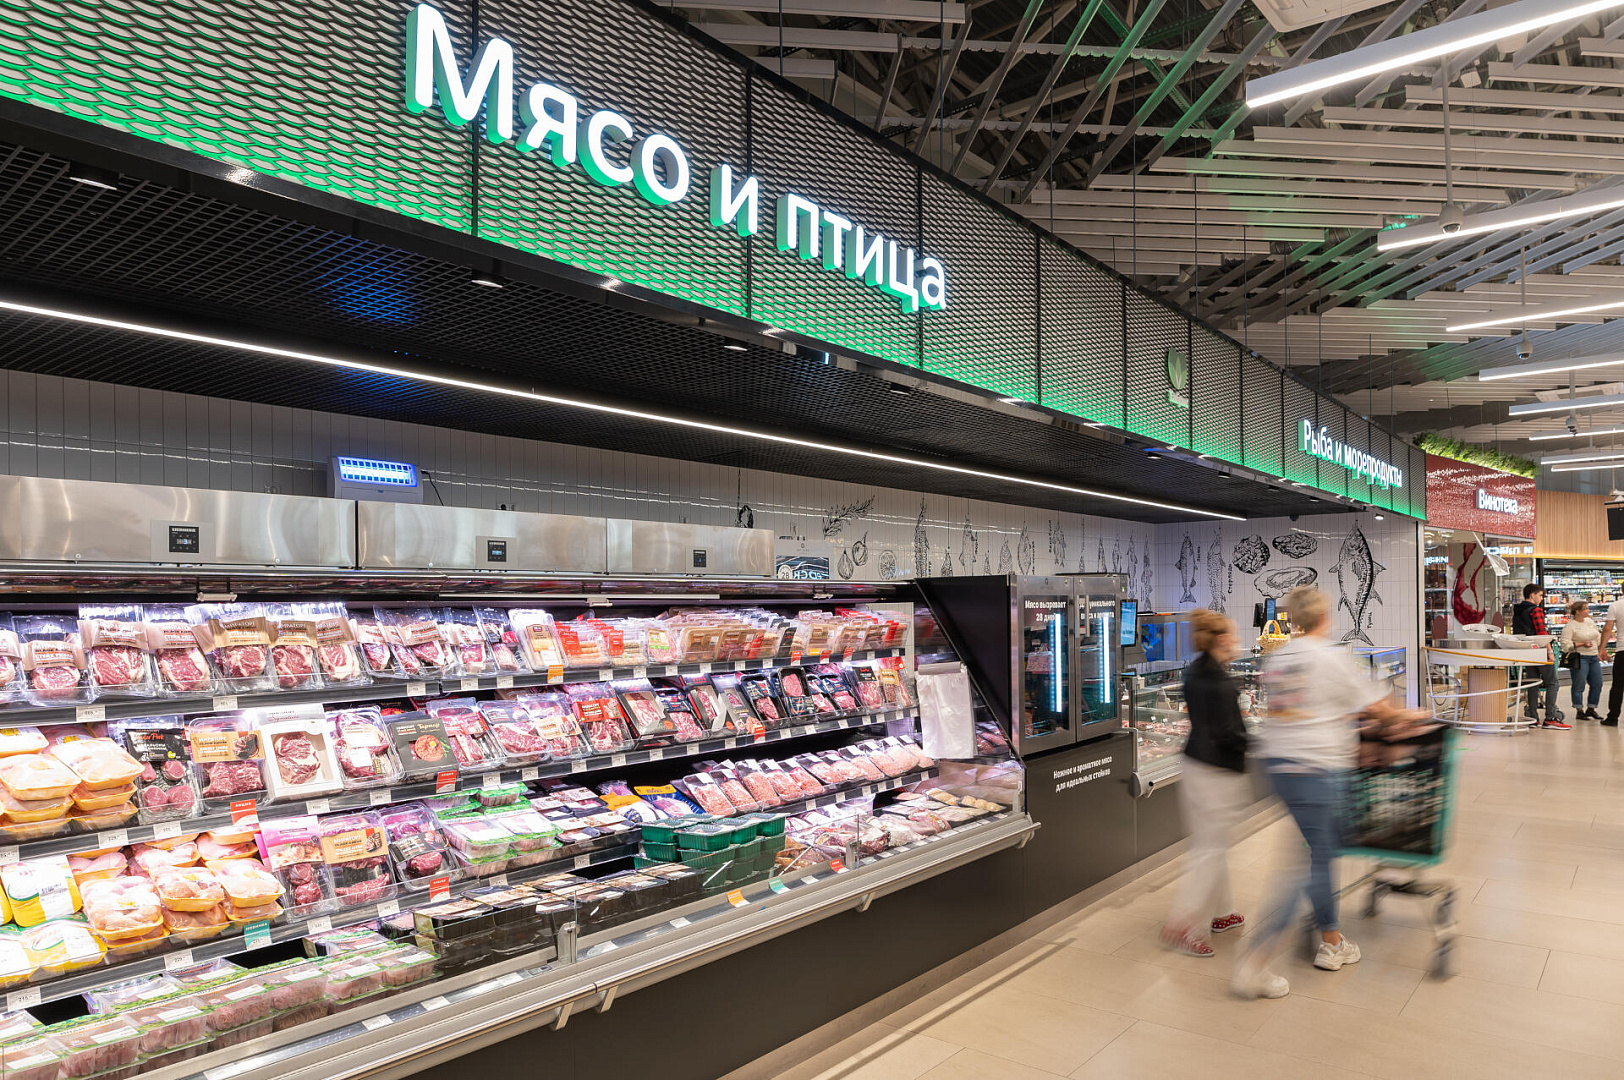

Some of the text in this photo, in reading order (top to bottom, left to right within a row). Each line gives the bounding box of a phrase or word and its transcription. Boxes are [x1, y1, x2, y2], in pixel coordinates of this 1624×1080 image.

[407, 3, 947, 312] Мясо и птица
[1301, 418, 1403, 490] Рыба и морепродукты
[1478, 488, 1519, 514] Винотека
[1025, 600, 1039, 609] Мясо
[1035, 612, 1043, 622] 28
